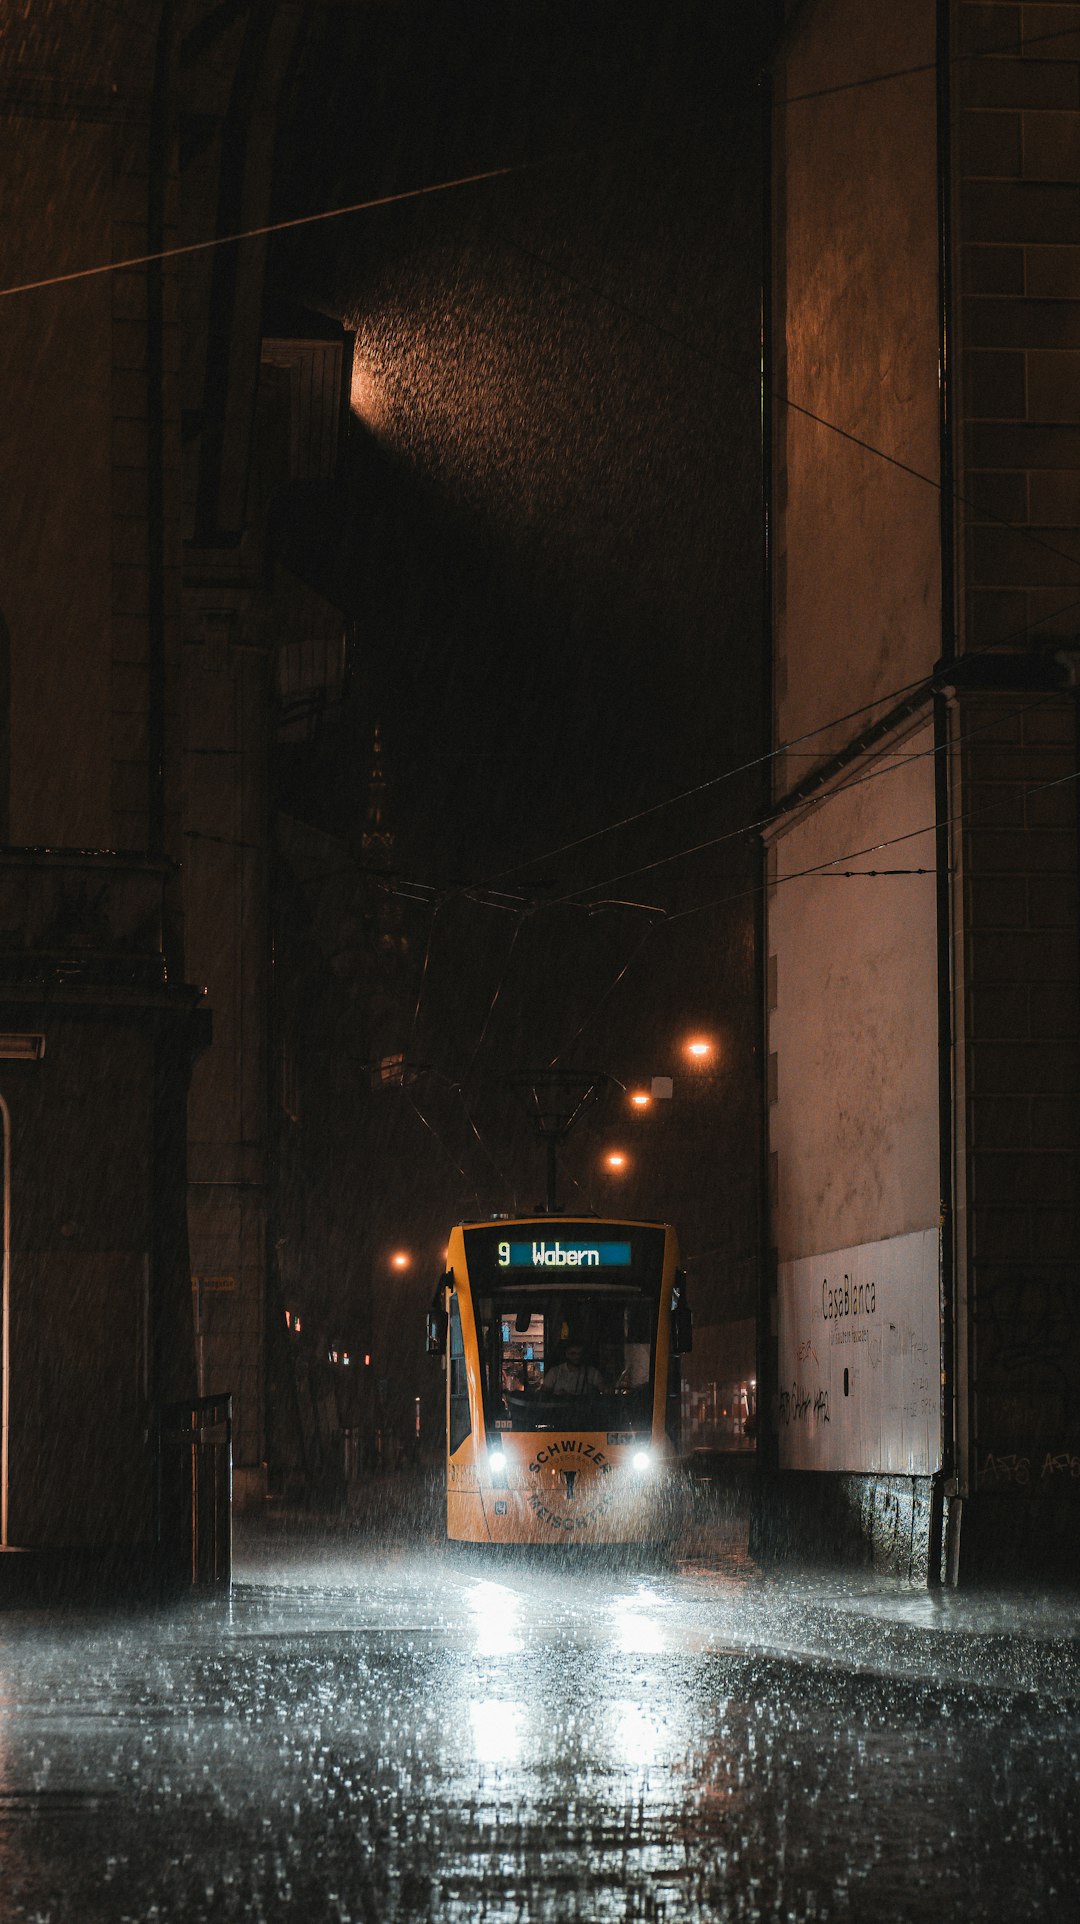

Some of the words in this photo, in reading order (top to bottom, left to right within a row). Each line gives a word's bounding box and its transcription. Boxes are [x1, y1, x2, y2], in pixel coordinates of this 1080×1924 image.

[498, 1241, 511, 1266] 9
[532, 1241, 600, 1266] Wabern
[822, 1274, 876, 1320] CasaBlanca
[529, 1440, 612, 1474] SCHWIZER
